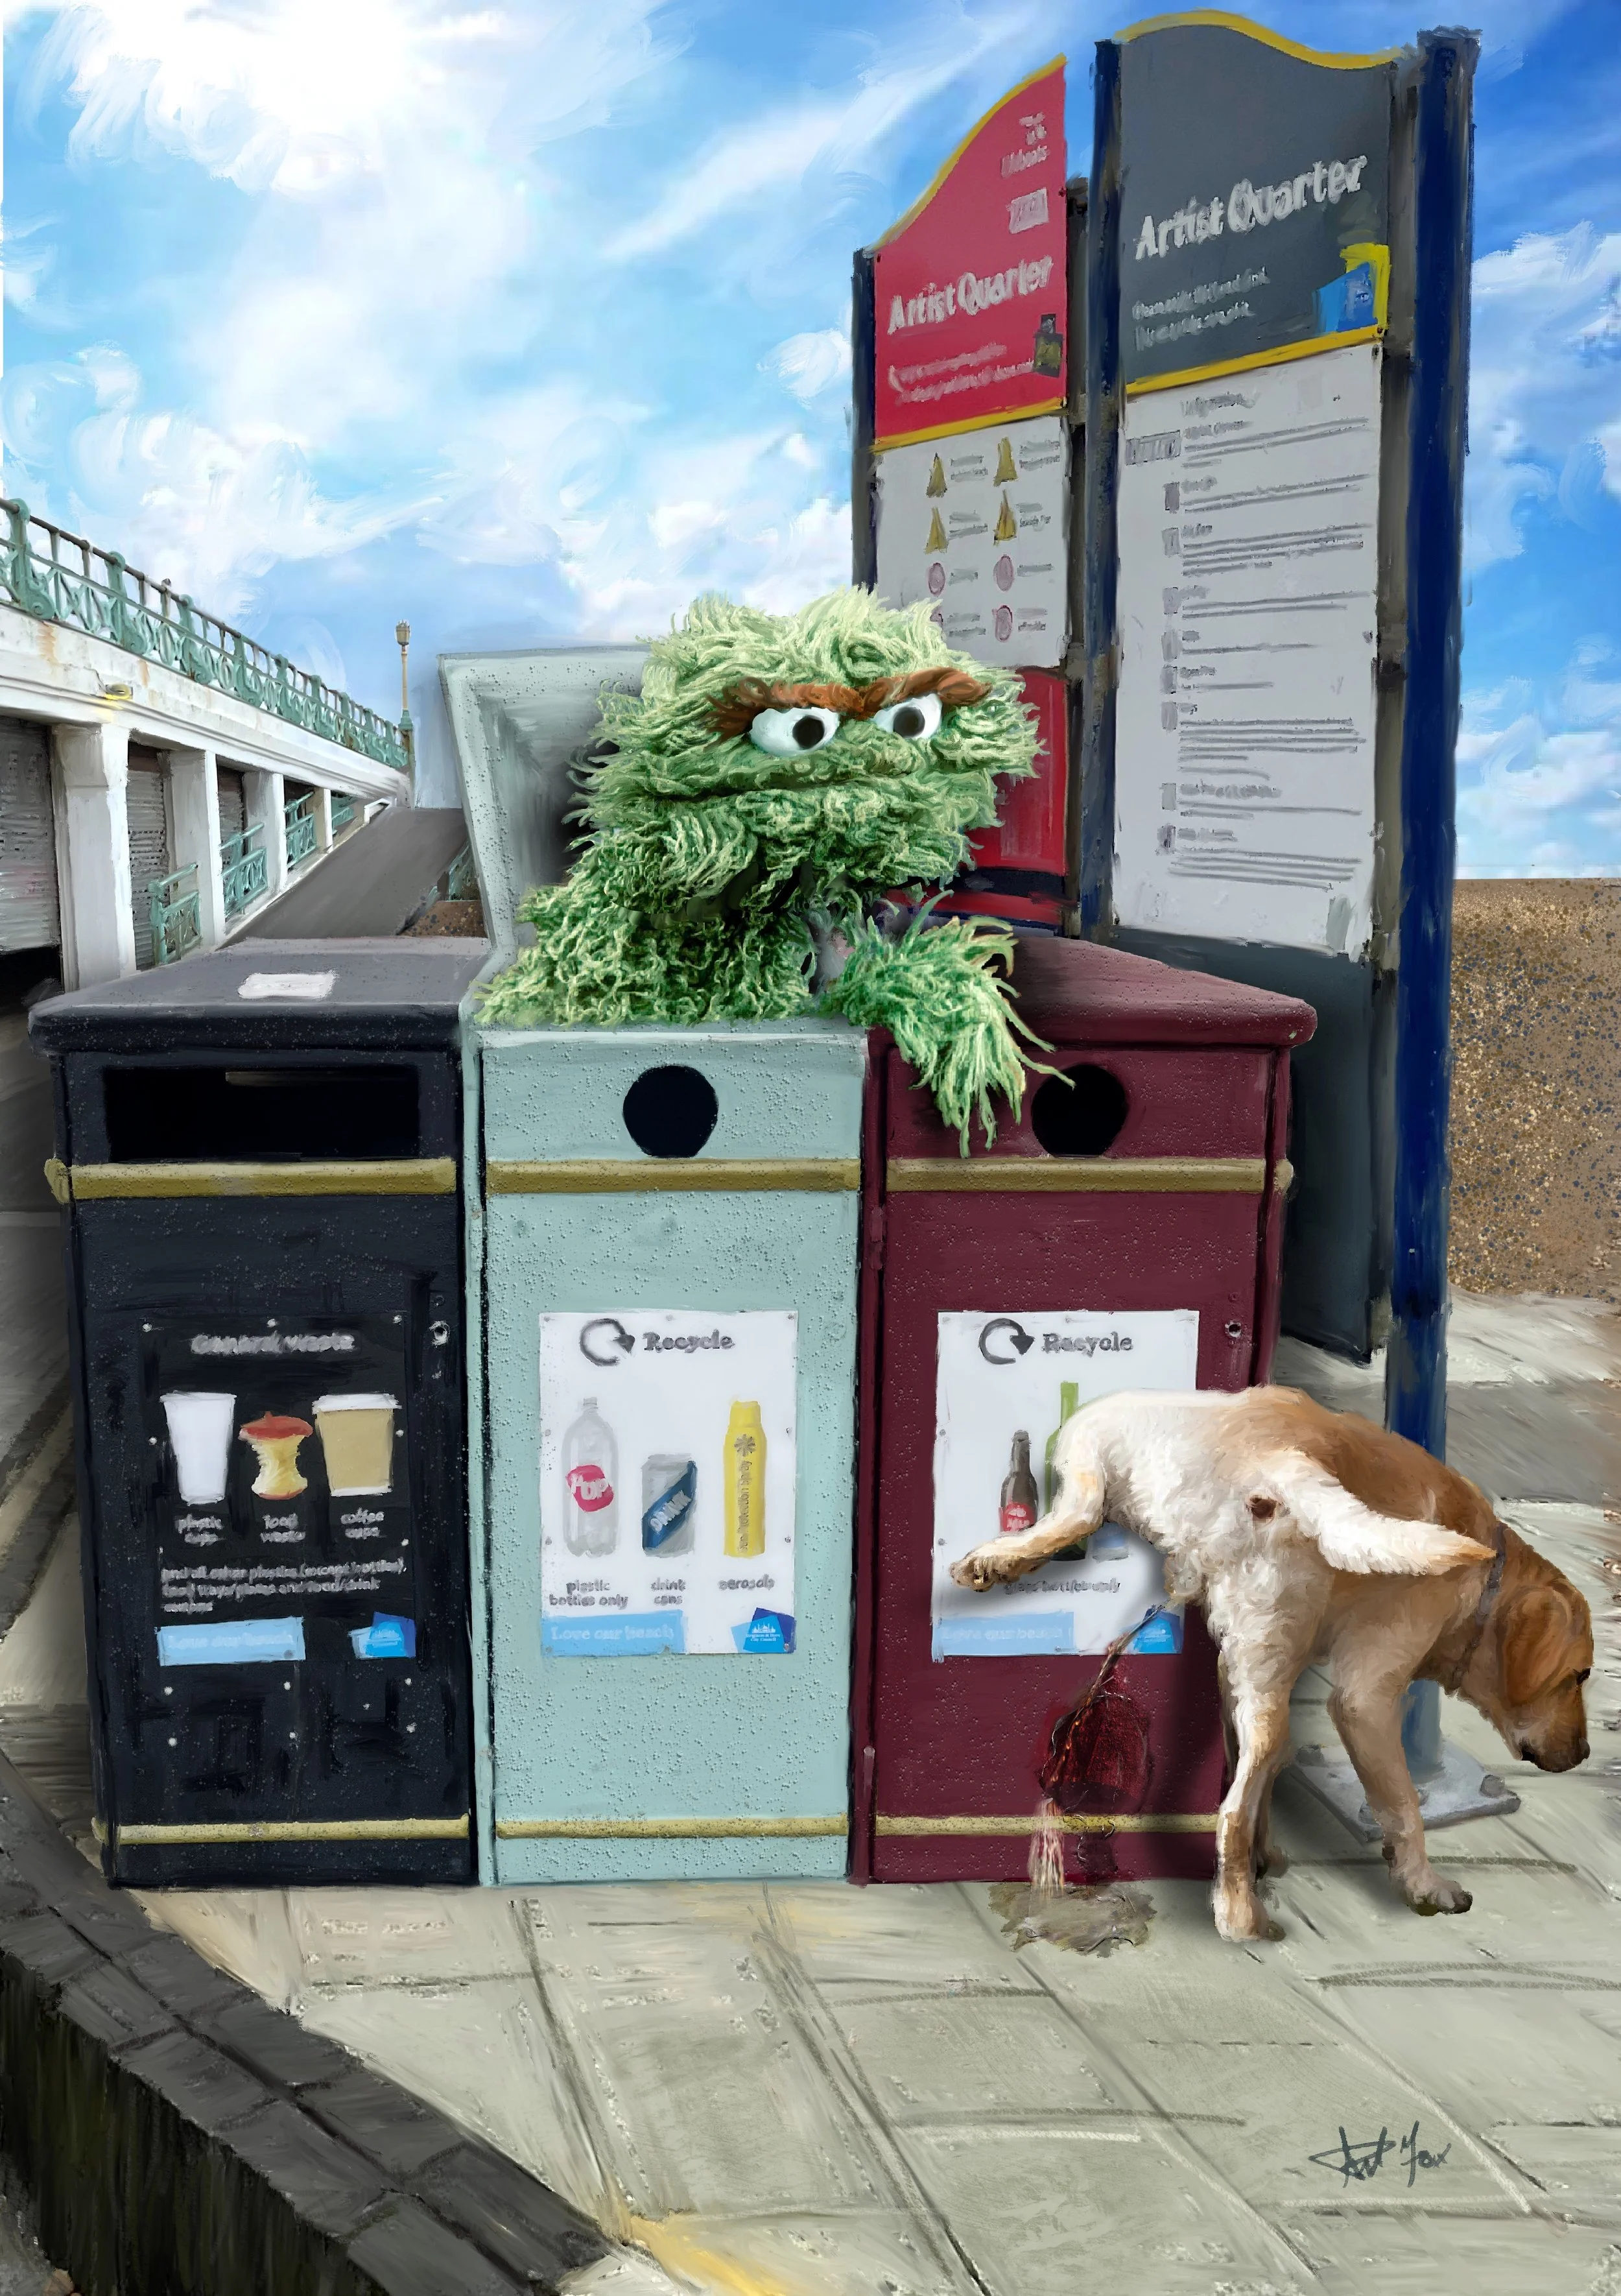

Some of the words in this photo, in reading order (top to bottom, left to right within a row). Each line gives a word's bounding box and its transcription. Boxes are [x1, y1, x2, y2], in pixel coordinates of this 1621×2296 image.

[1133, 196, 1224, 261] Artist
[1227, 155, 1367, 233] Quarter
[887, 282, 956, 335] Artist
[957, 255, 1054, 315] Quarter
[642, 1328, 735, 1354] Recycle
[1041, 1331, 1134, 1358] Recycle
[650, 1577, 687, 1592] drink
[598, 1594, 629, 1610] only
[551, 1626, 591, 1640] Love
